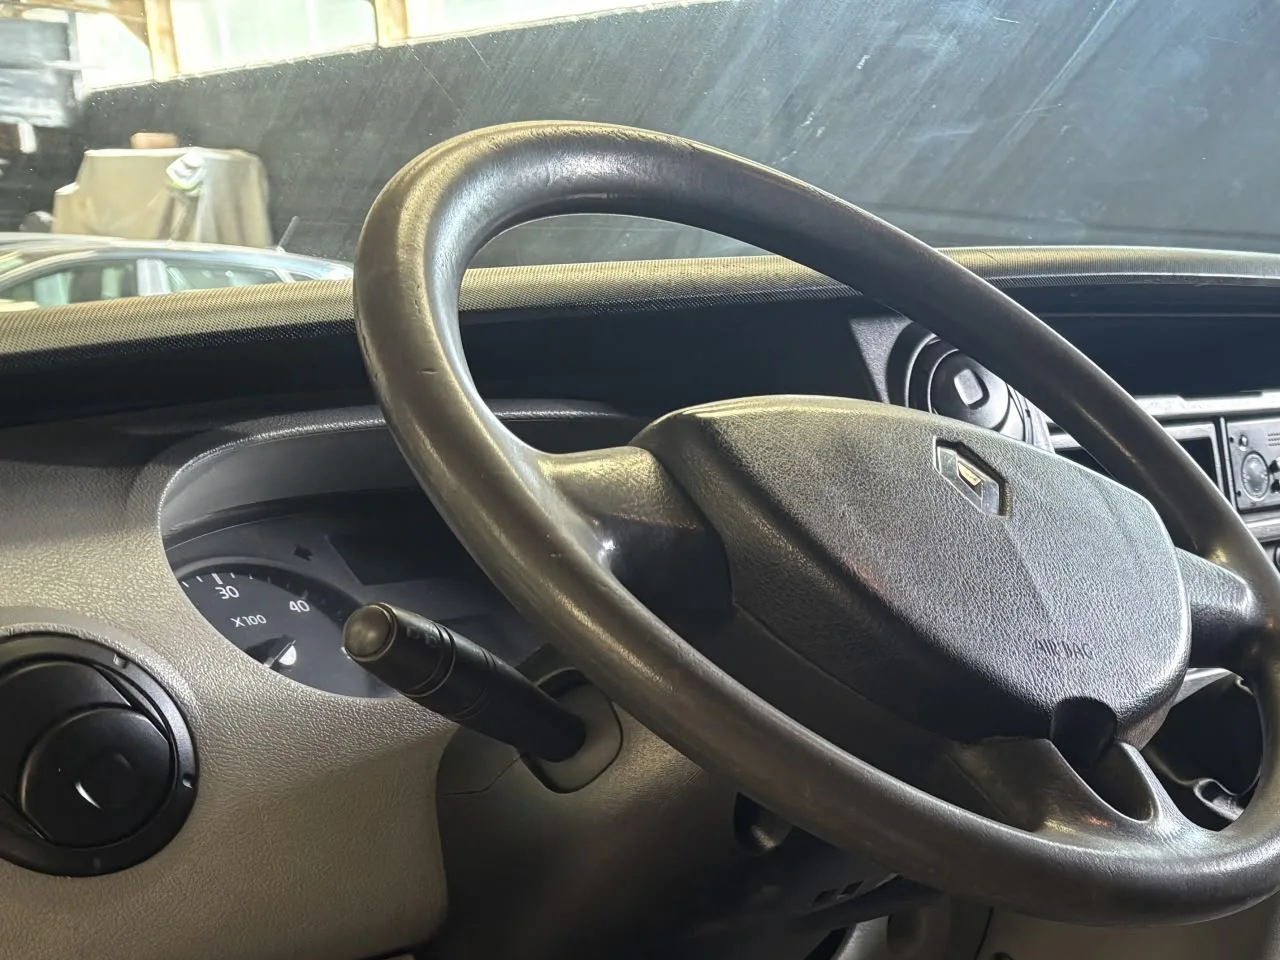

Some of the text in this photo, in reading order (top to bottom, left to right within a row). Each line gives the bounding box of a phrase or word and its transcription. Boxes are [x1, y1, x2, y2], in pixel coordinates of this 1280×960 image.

[214, 585, 240, 600] 30
[289, 599, 310, 613] 40
[230, 614, 267, 628] X100
